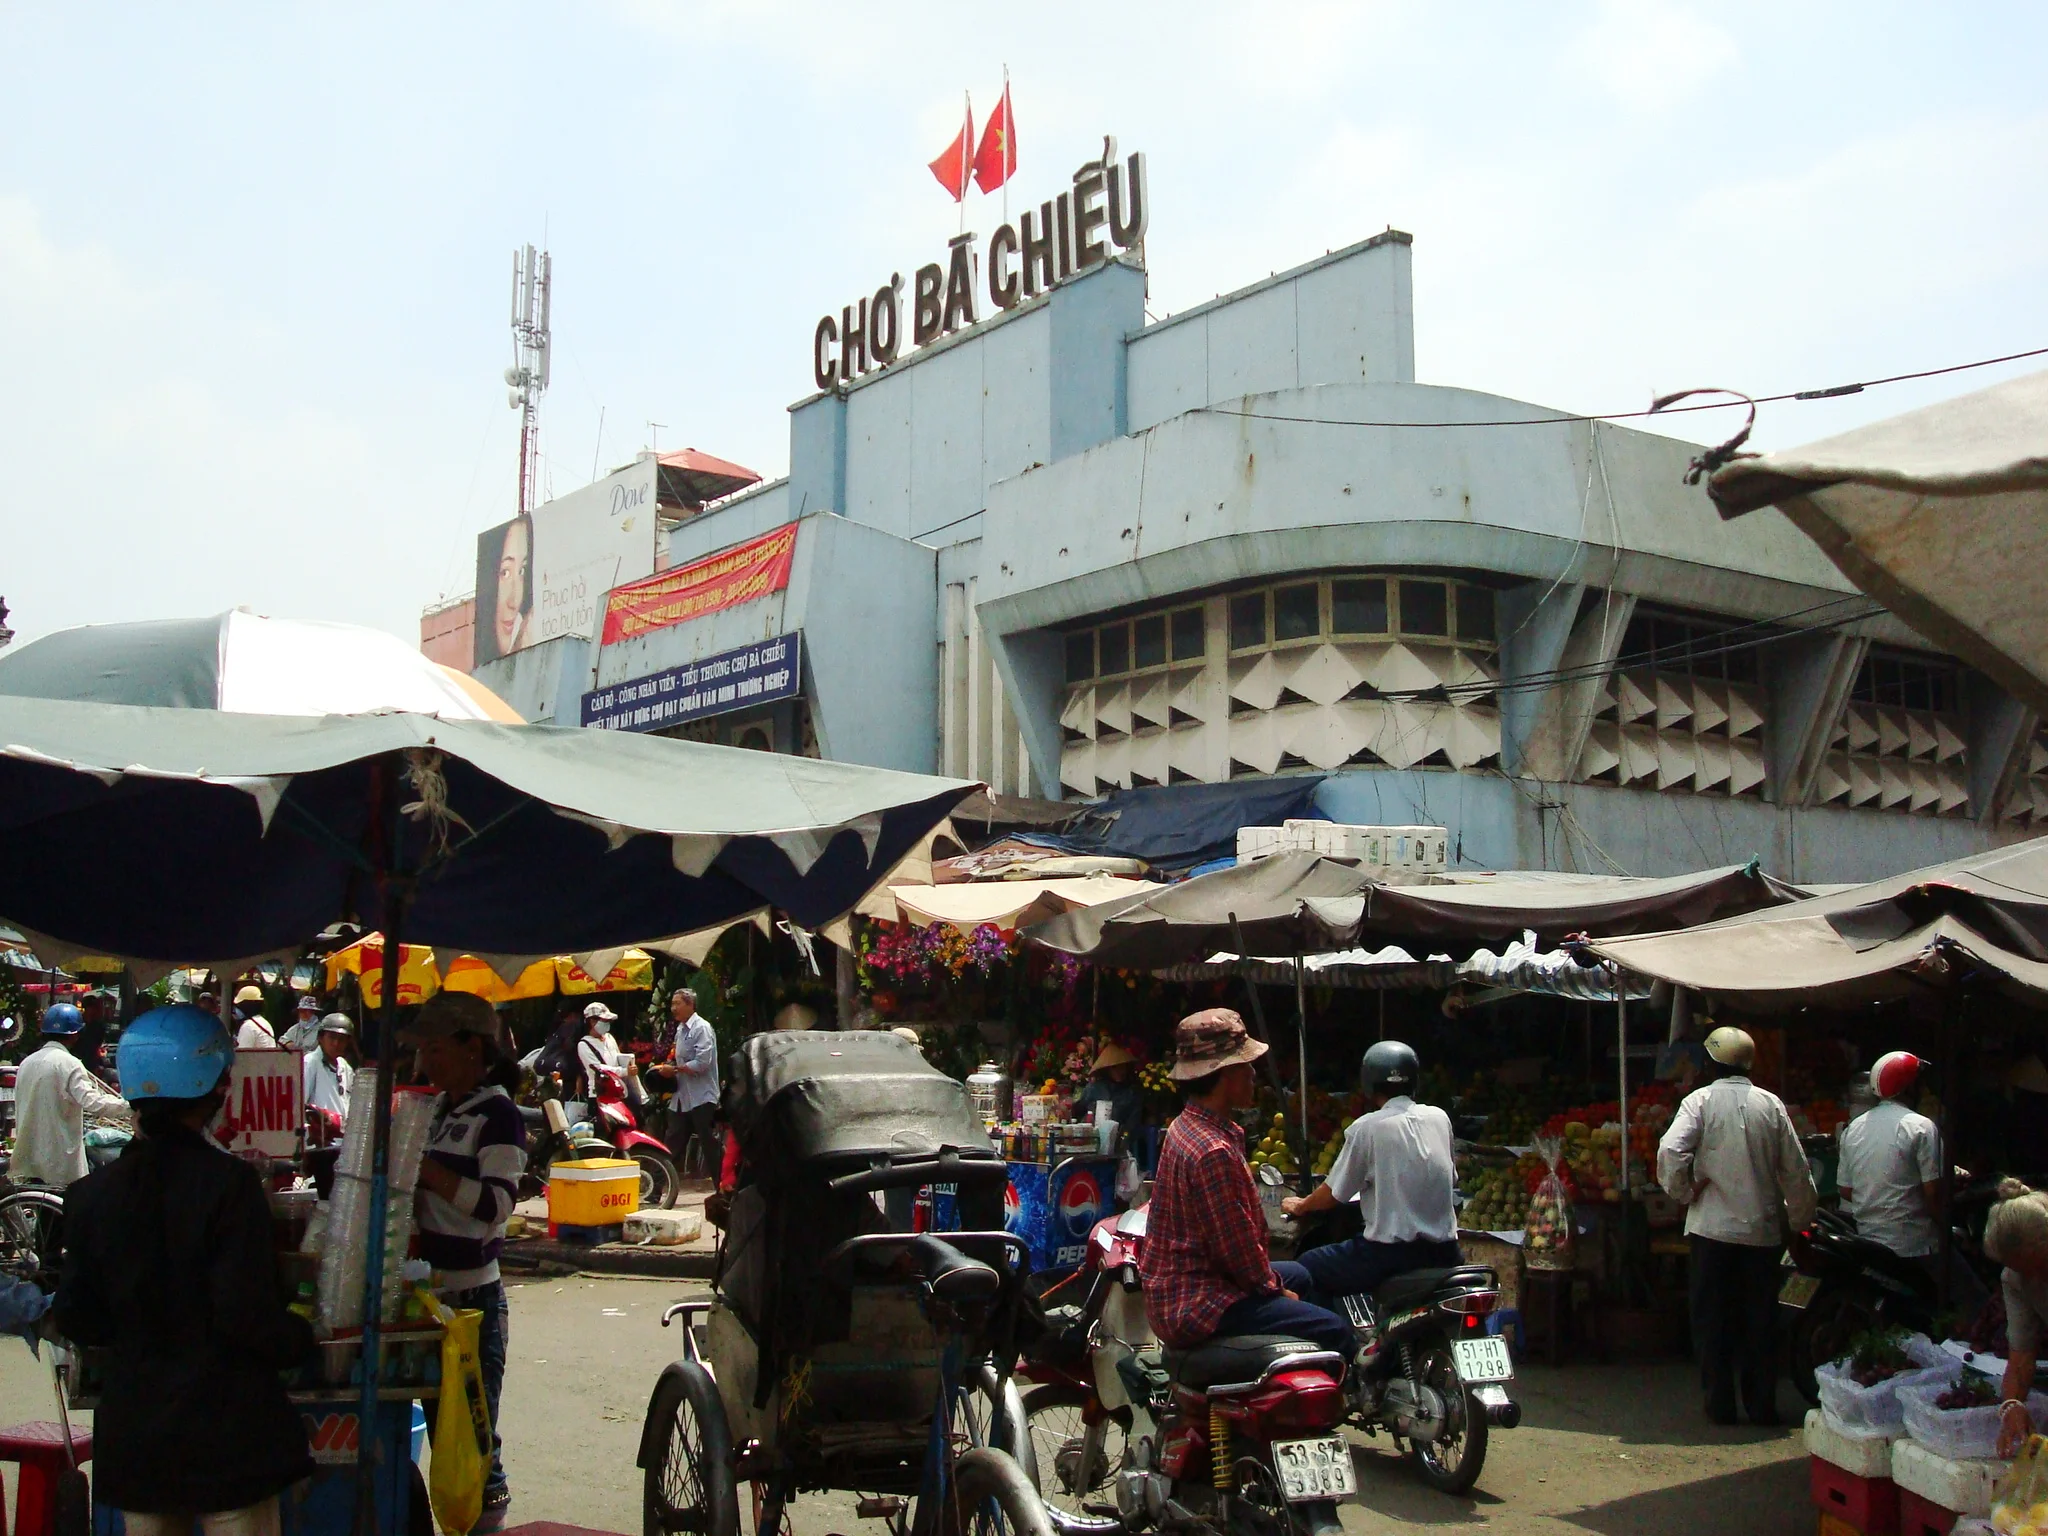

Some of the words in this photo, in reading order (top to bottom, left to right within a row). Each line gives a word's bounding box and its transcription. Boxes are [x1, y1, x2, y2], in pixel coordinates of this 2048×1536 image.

[814, 272, 905, 390] CHỢ
[914, 231, 980, 346] BÀ
[989, 134, 1148, 307] CHIỂU
[610, 483, 649, 516] Dove
[1056, 1245, 1088, 1264] PEP
[1465, 1359, 1505, 1379] 1298
